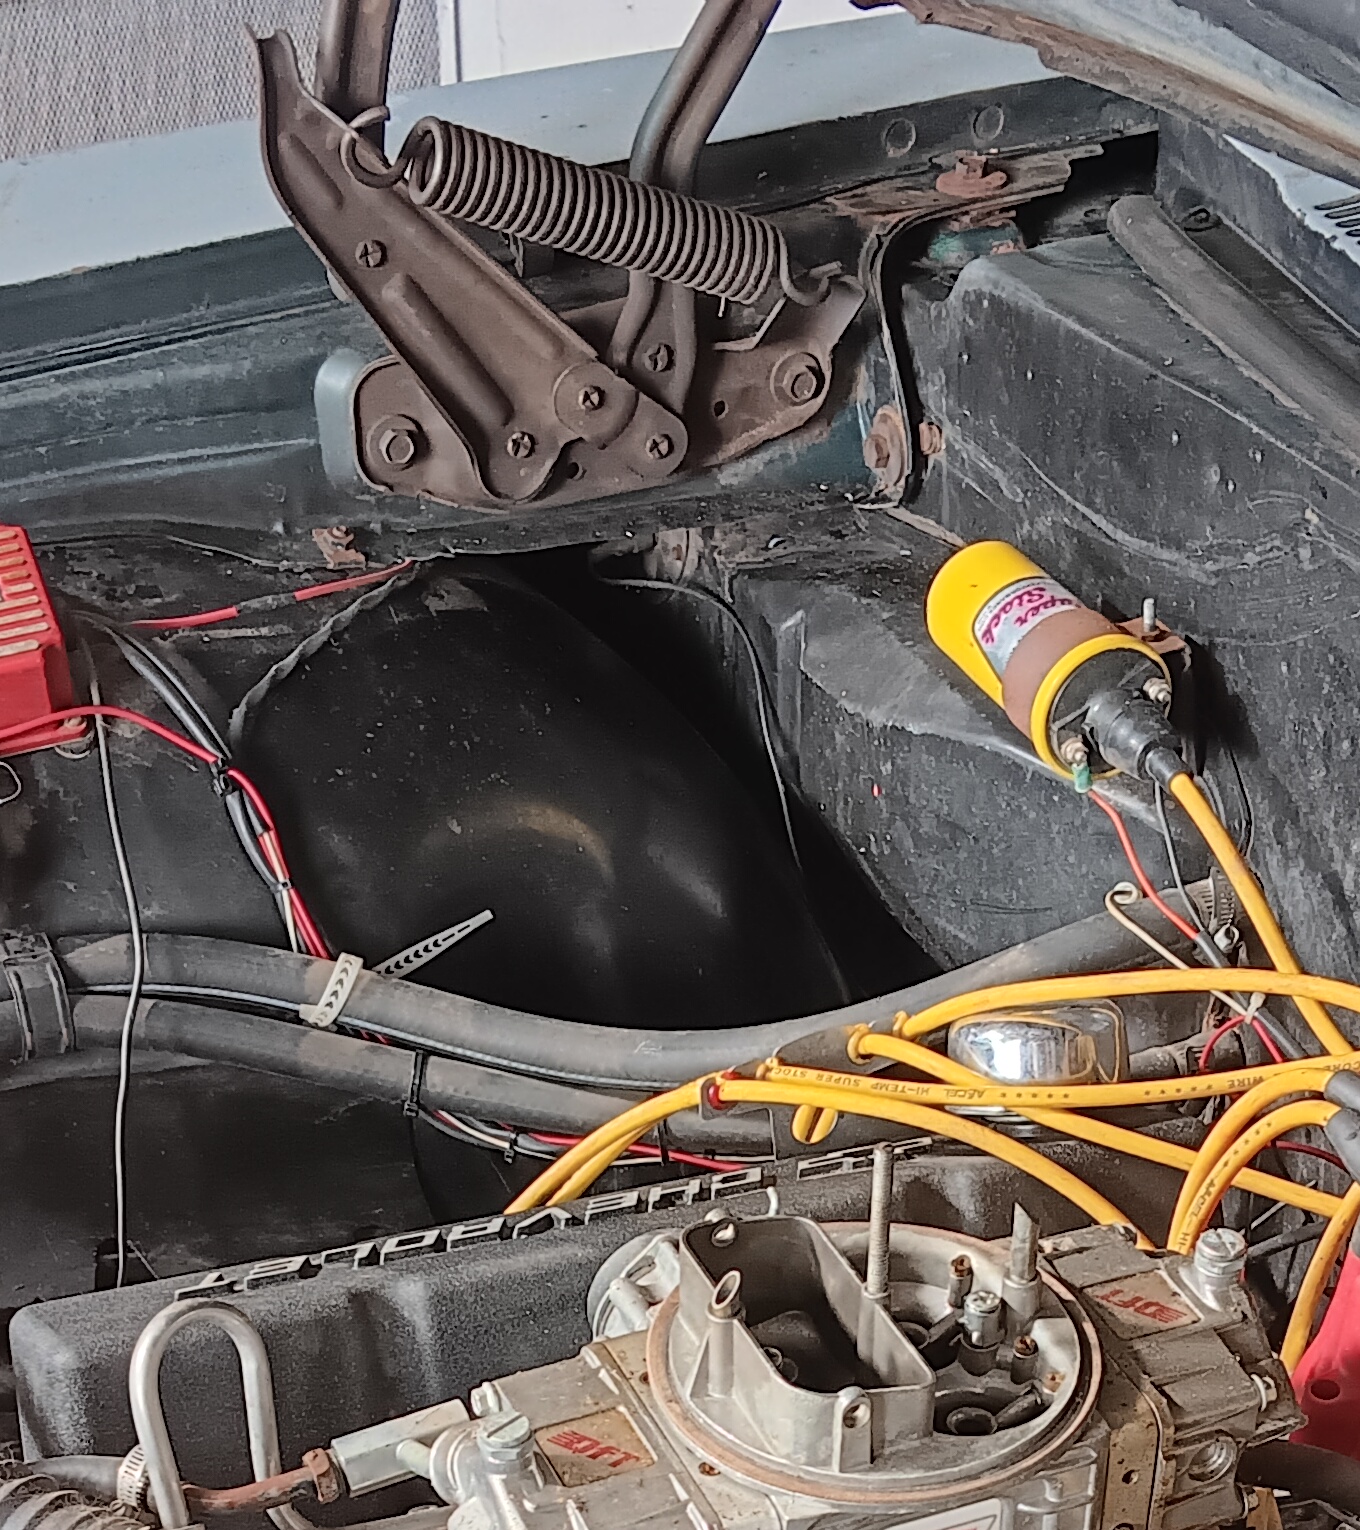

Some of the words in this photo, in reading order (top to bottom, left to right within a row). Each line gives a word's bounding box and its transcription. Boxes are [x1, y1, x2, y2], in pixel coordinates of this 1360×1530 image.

[1013, 595, 1081, 628] uper
[814, 1071, 862, 1088] SUPER
[869, 1080, 930, 1098] HI-TEMP
